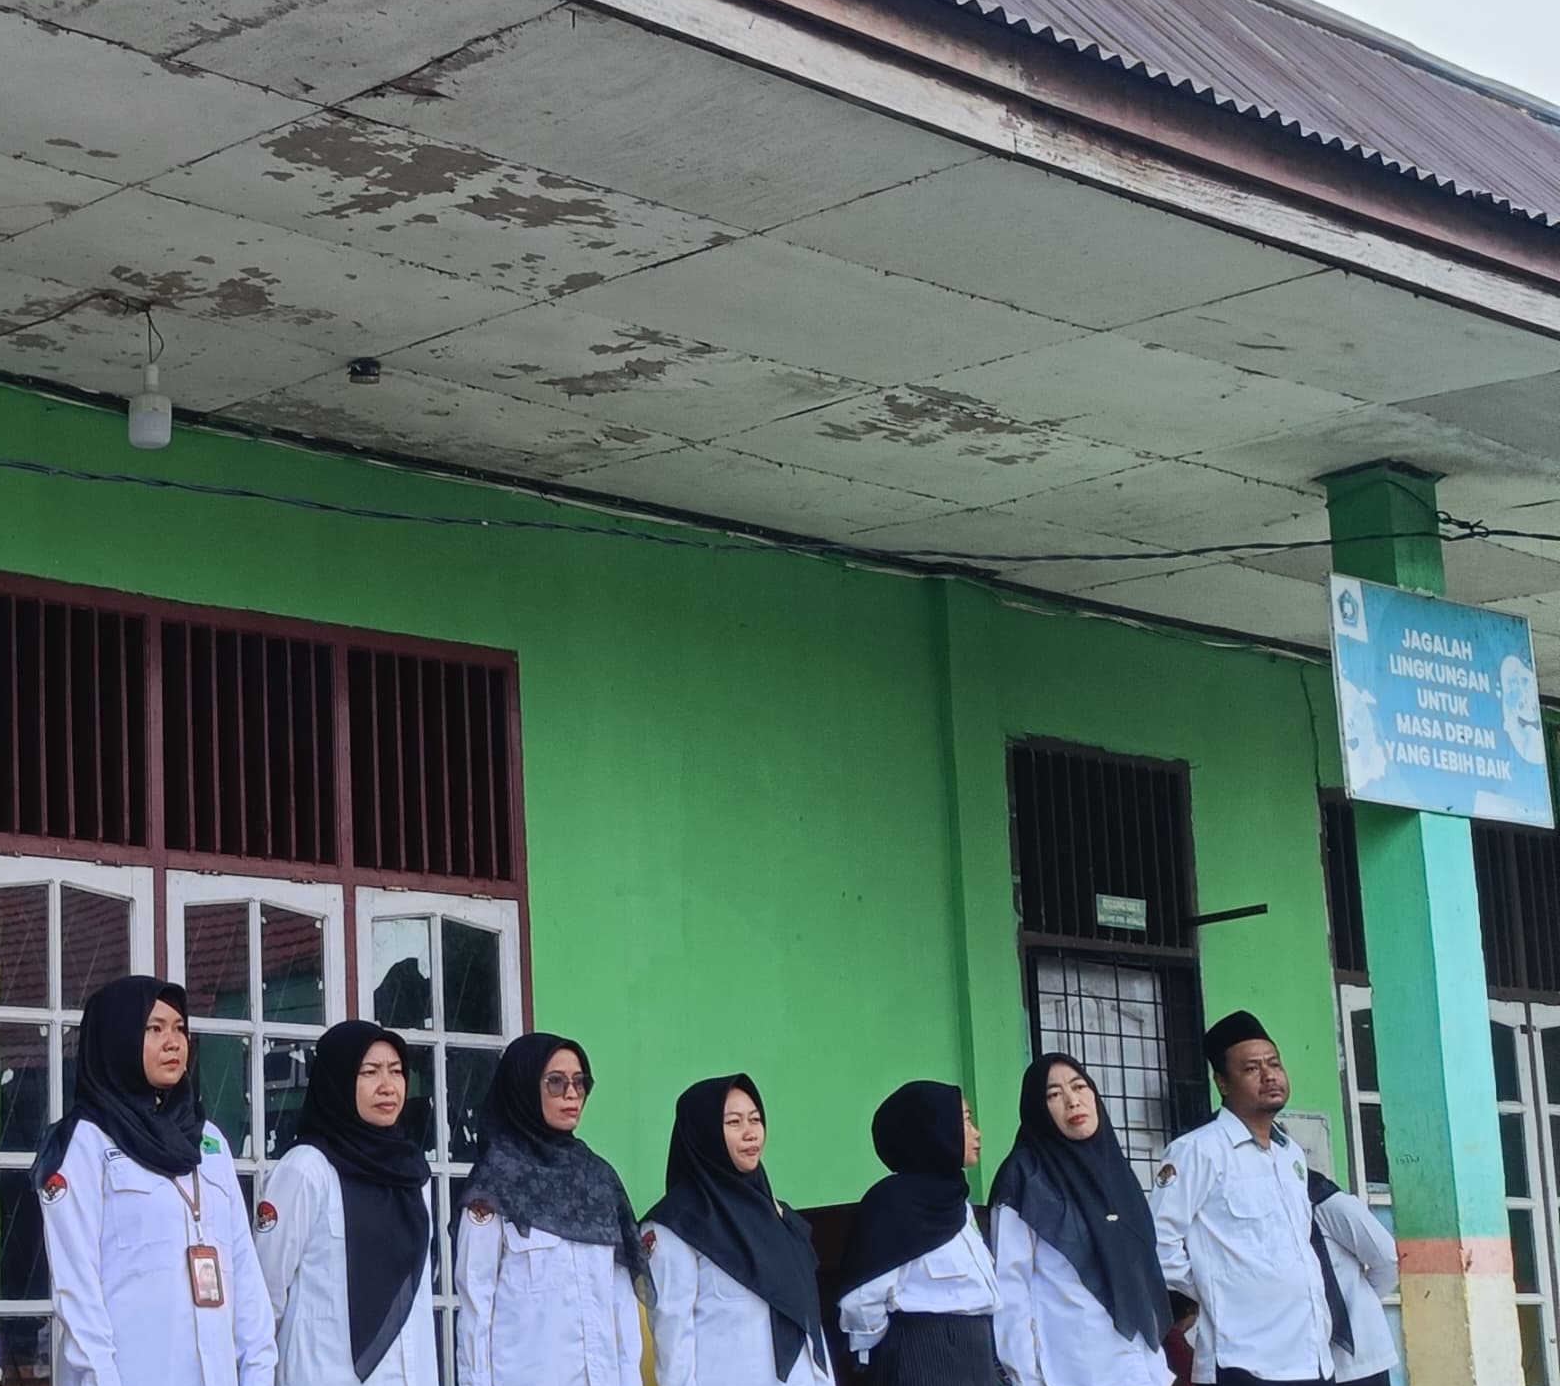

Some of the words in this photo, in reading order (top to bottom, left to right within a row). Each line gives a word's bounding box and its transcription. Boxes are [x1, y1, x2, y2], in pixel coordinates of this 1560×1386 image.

[1401, 628, 1473, 661] JAGALAH
[1389, 652, 1490, 694] LINGKUNGAN
[1416, 687, 1470, 717] UNTUK
[1396, 712, 1444, 741] MASA
[1444, 721, 1496, 750] DEPAN
[1384, 739, 1431, 767] YANG
[1432, 748, 1474, 774] LEBIH
[1475, 756, 1512, 781] BAIK
